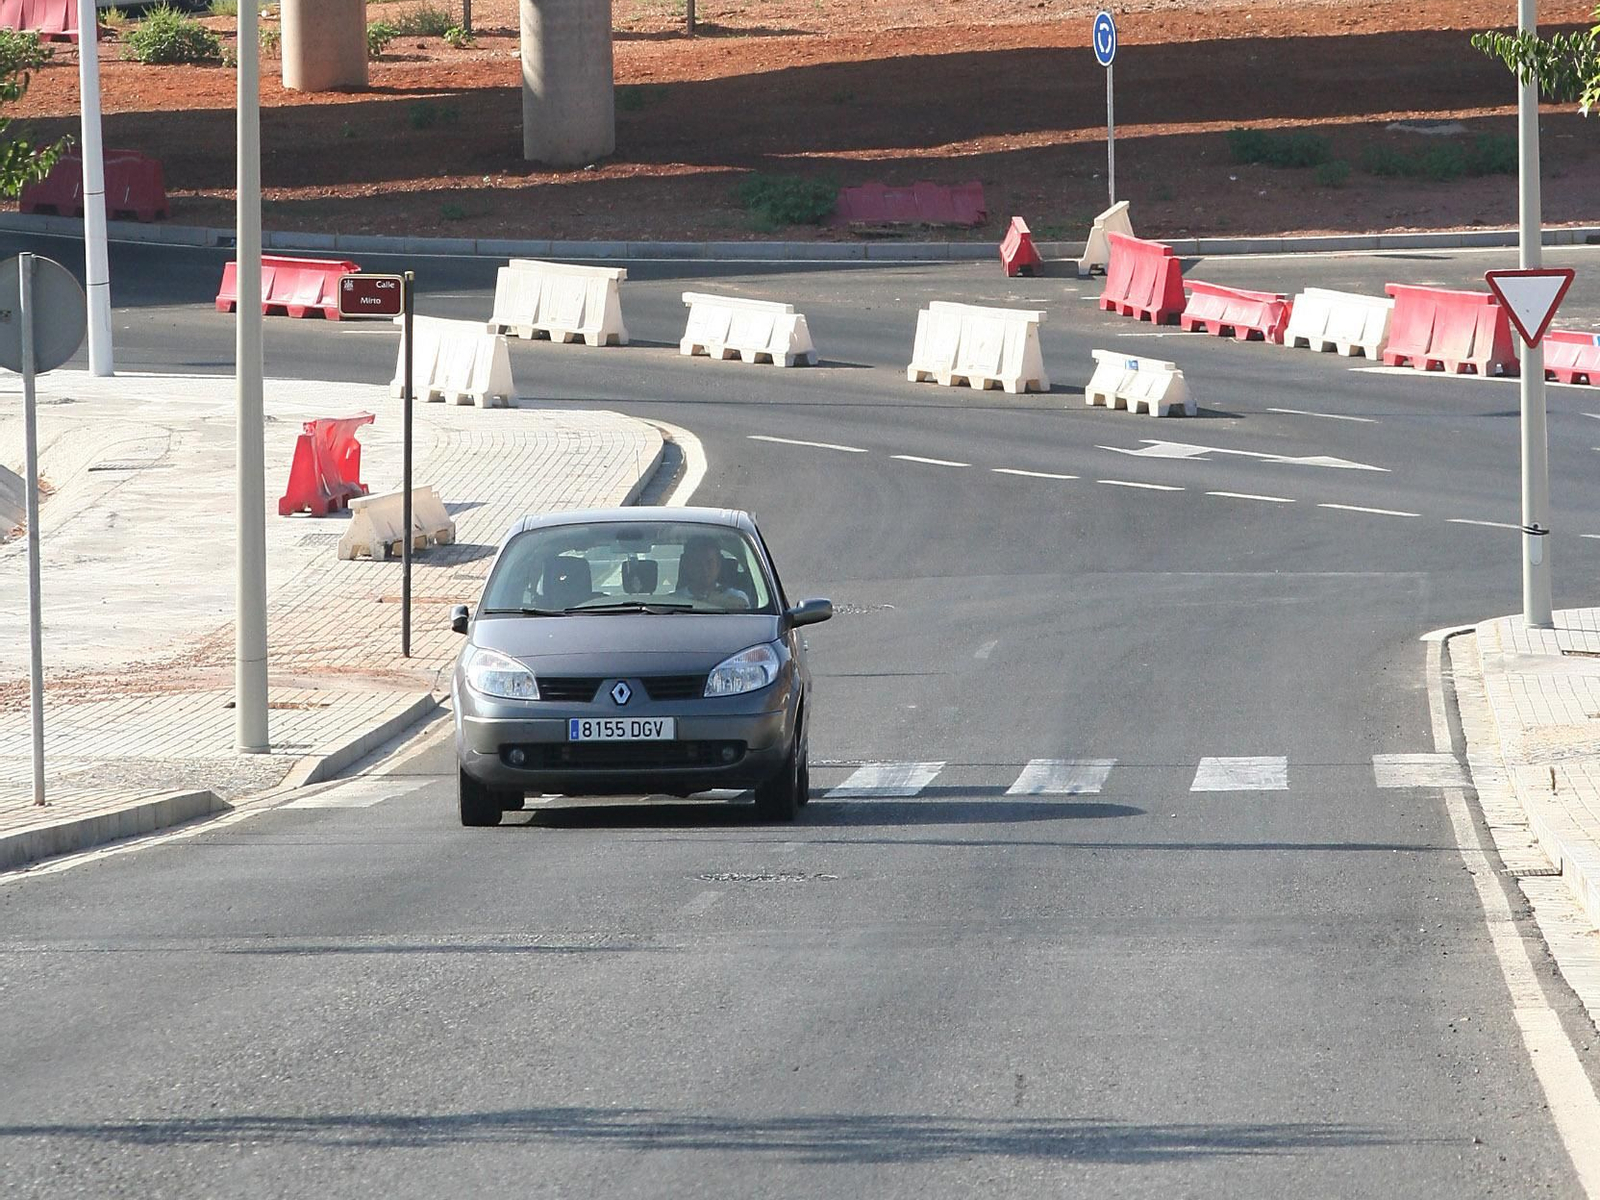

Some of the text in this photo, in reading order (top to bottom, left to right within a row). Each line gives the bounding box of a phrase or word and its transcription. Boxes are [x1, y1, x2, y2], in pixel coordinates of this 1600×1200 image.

[375, 280, 395, 289] Calle
[360, 296, 382, 305] Mirto
[582, 721, 625, 738] 8155
[631, 721, 664, 738] DGV
